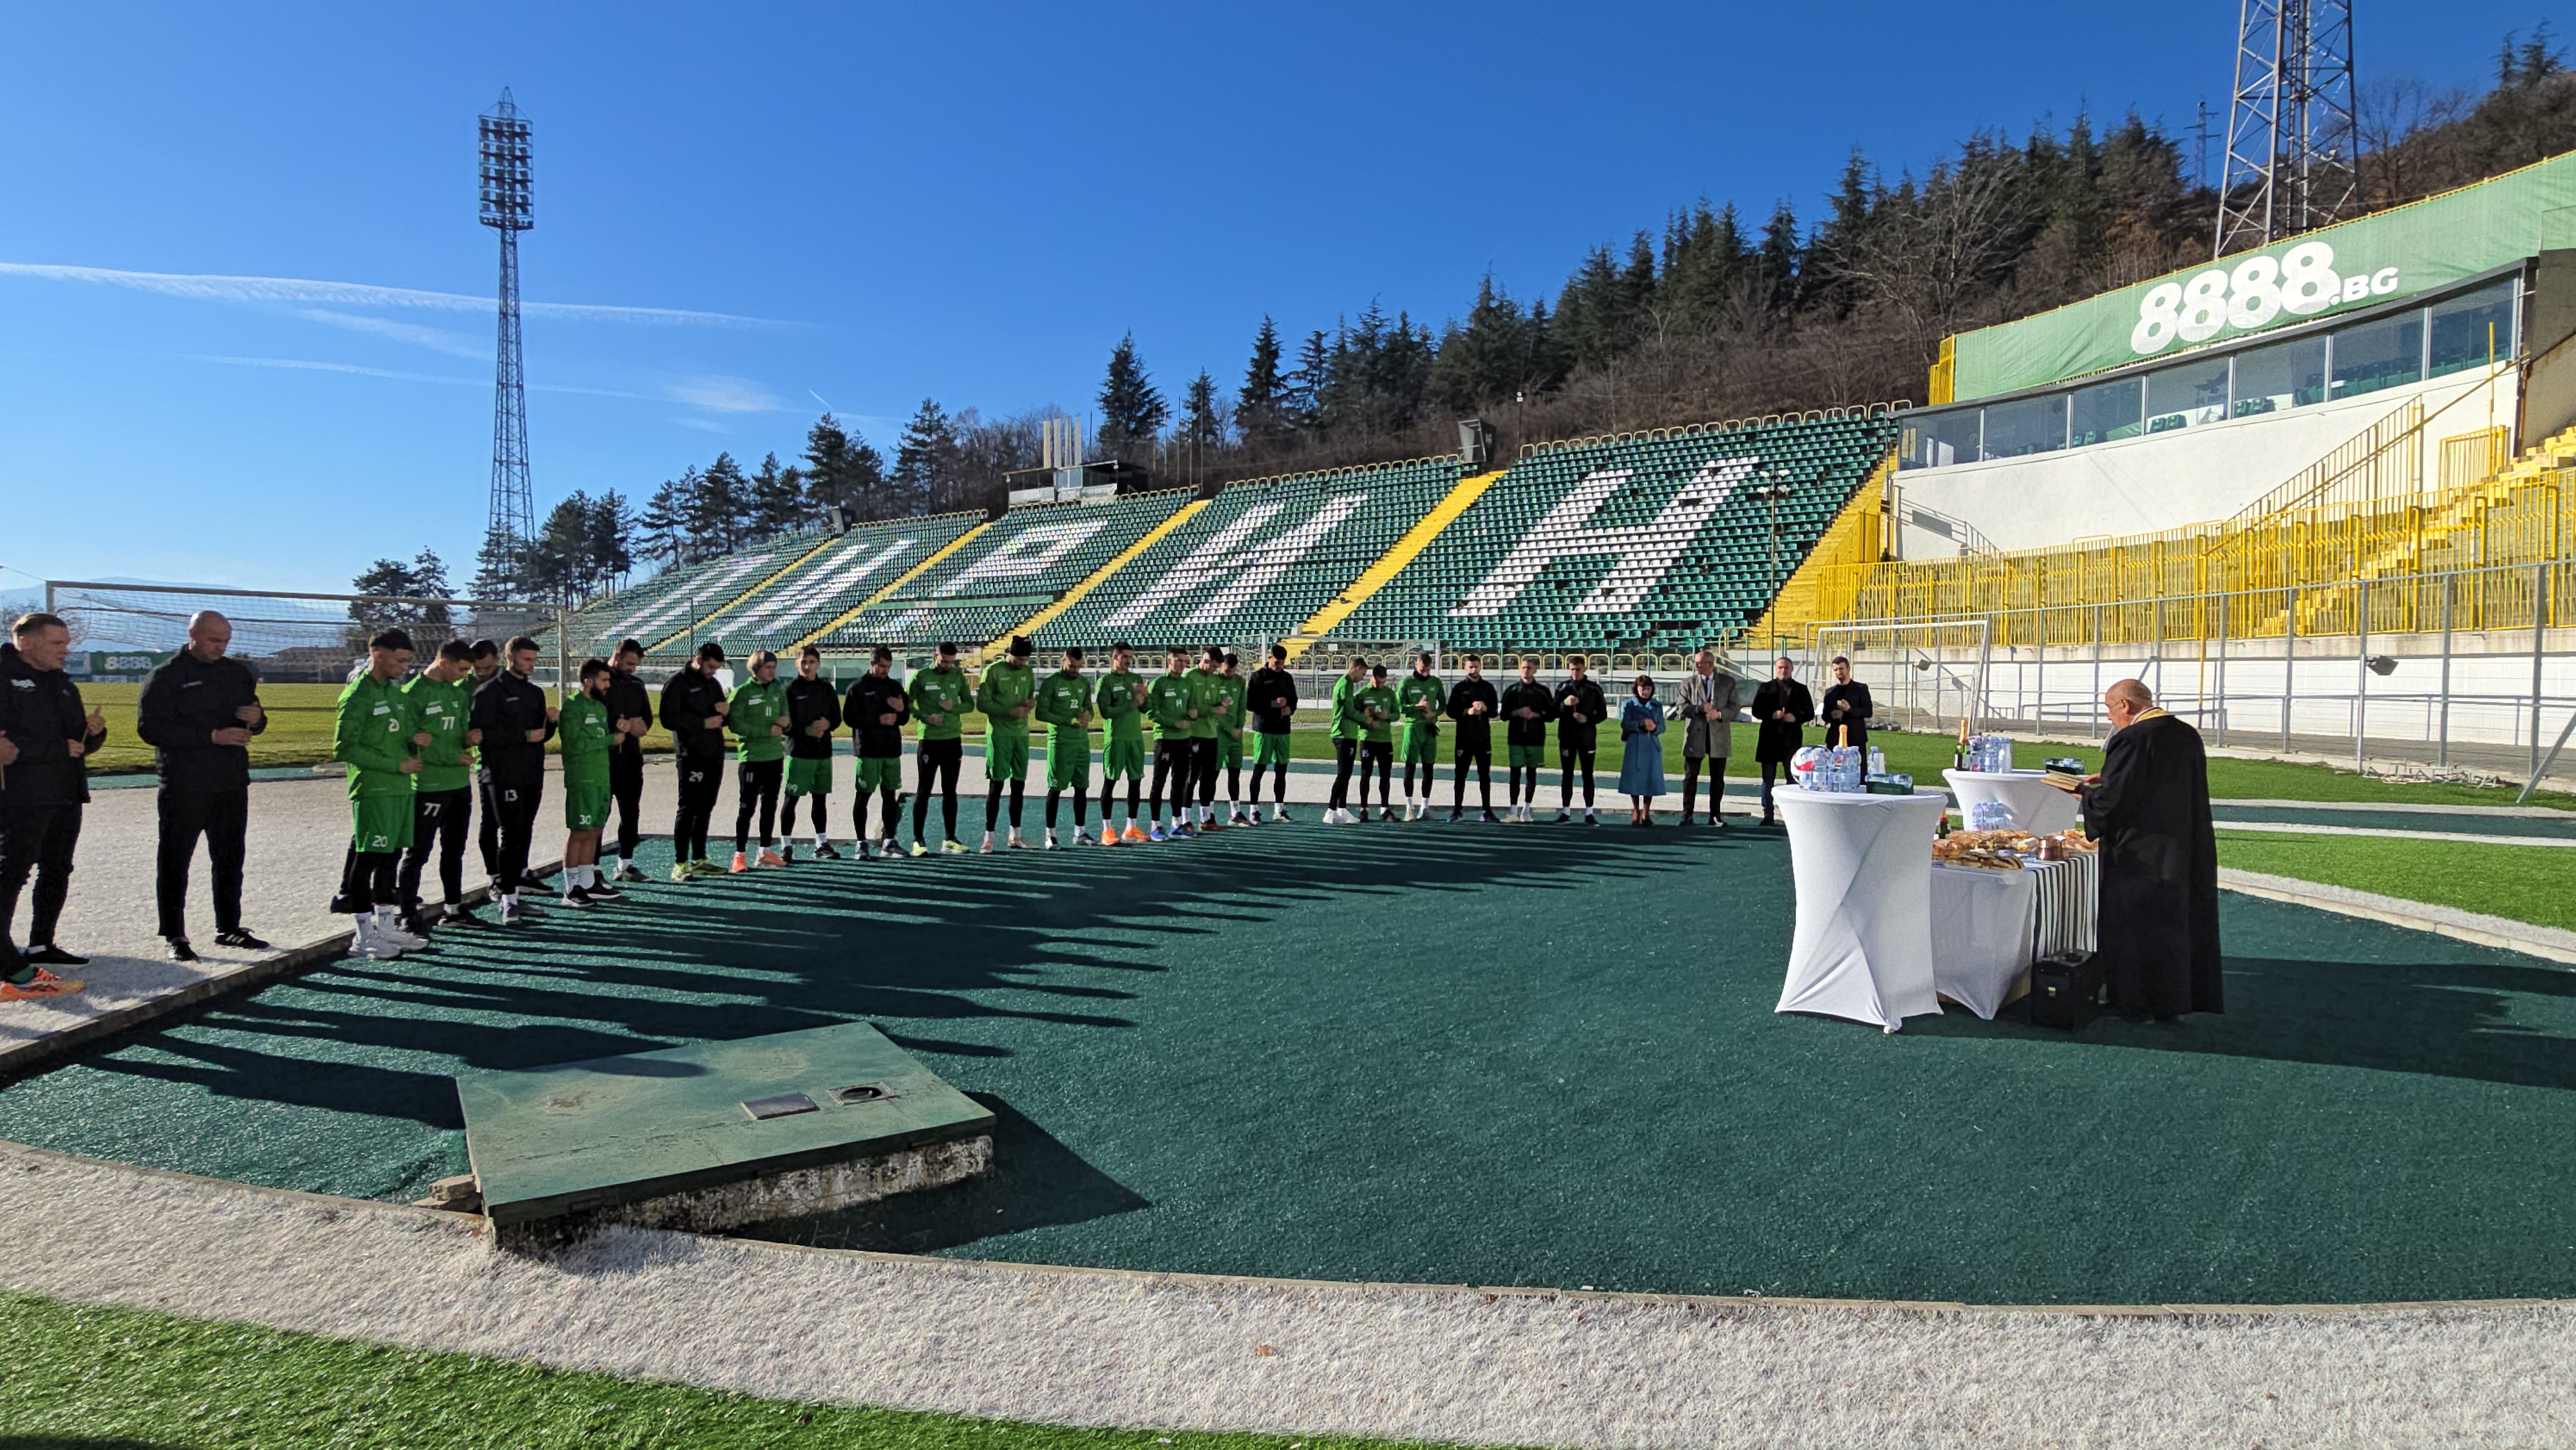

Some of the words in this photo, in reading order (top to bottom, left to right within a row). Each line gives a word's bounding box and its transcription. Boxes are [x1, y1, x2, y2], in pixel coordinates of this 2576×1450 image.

[2130, 241, 2399, 355] 8888.BG
[441, 716, 455, 730] 77
[688, 771, 704, 782] 29
[505, 789, 518, 802] 13
[423, 803, 441, 817] 77
[579, 814, 592, 825] 30
[372, 835, 388, 847] 20
